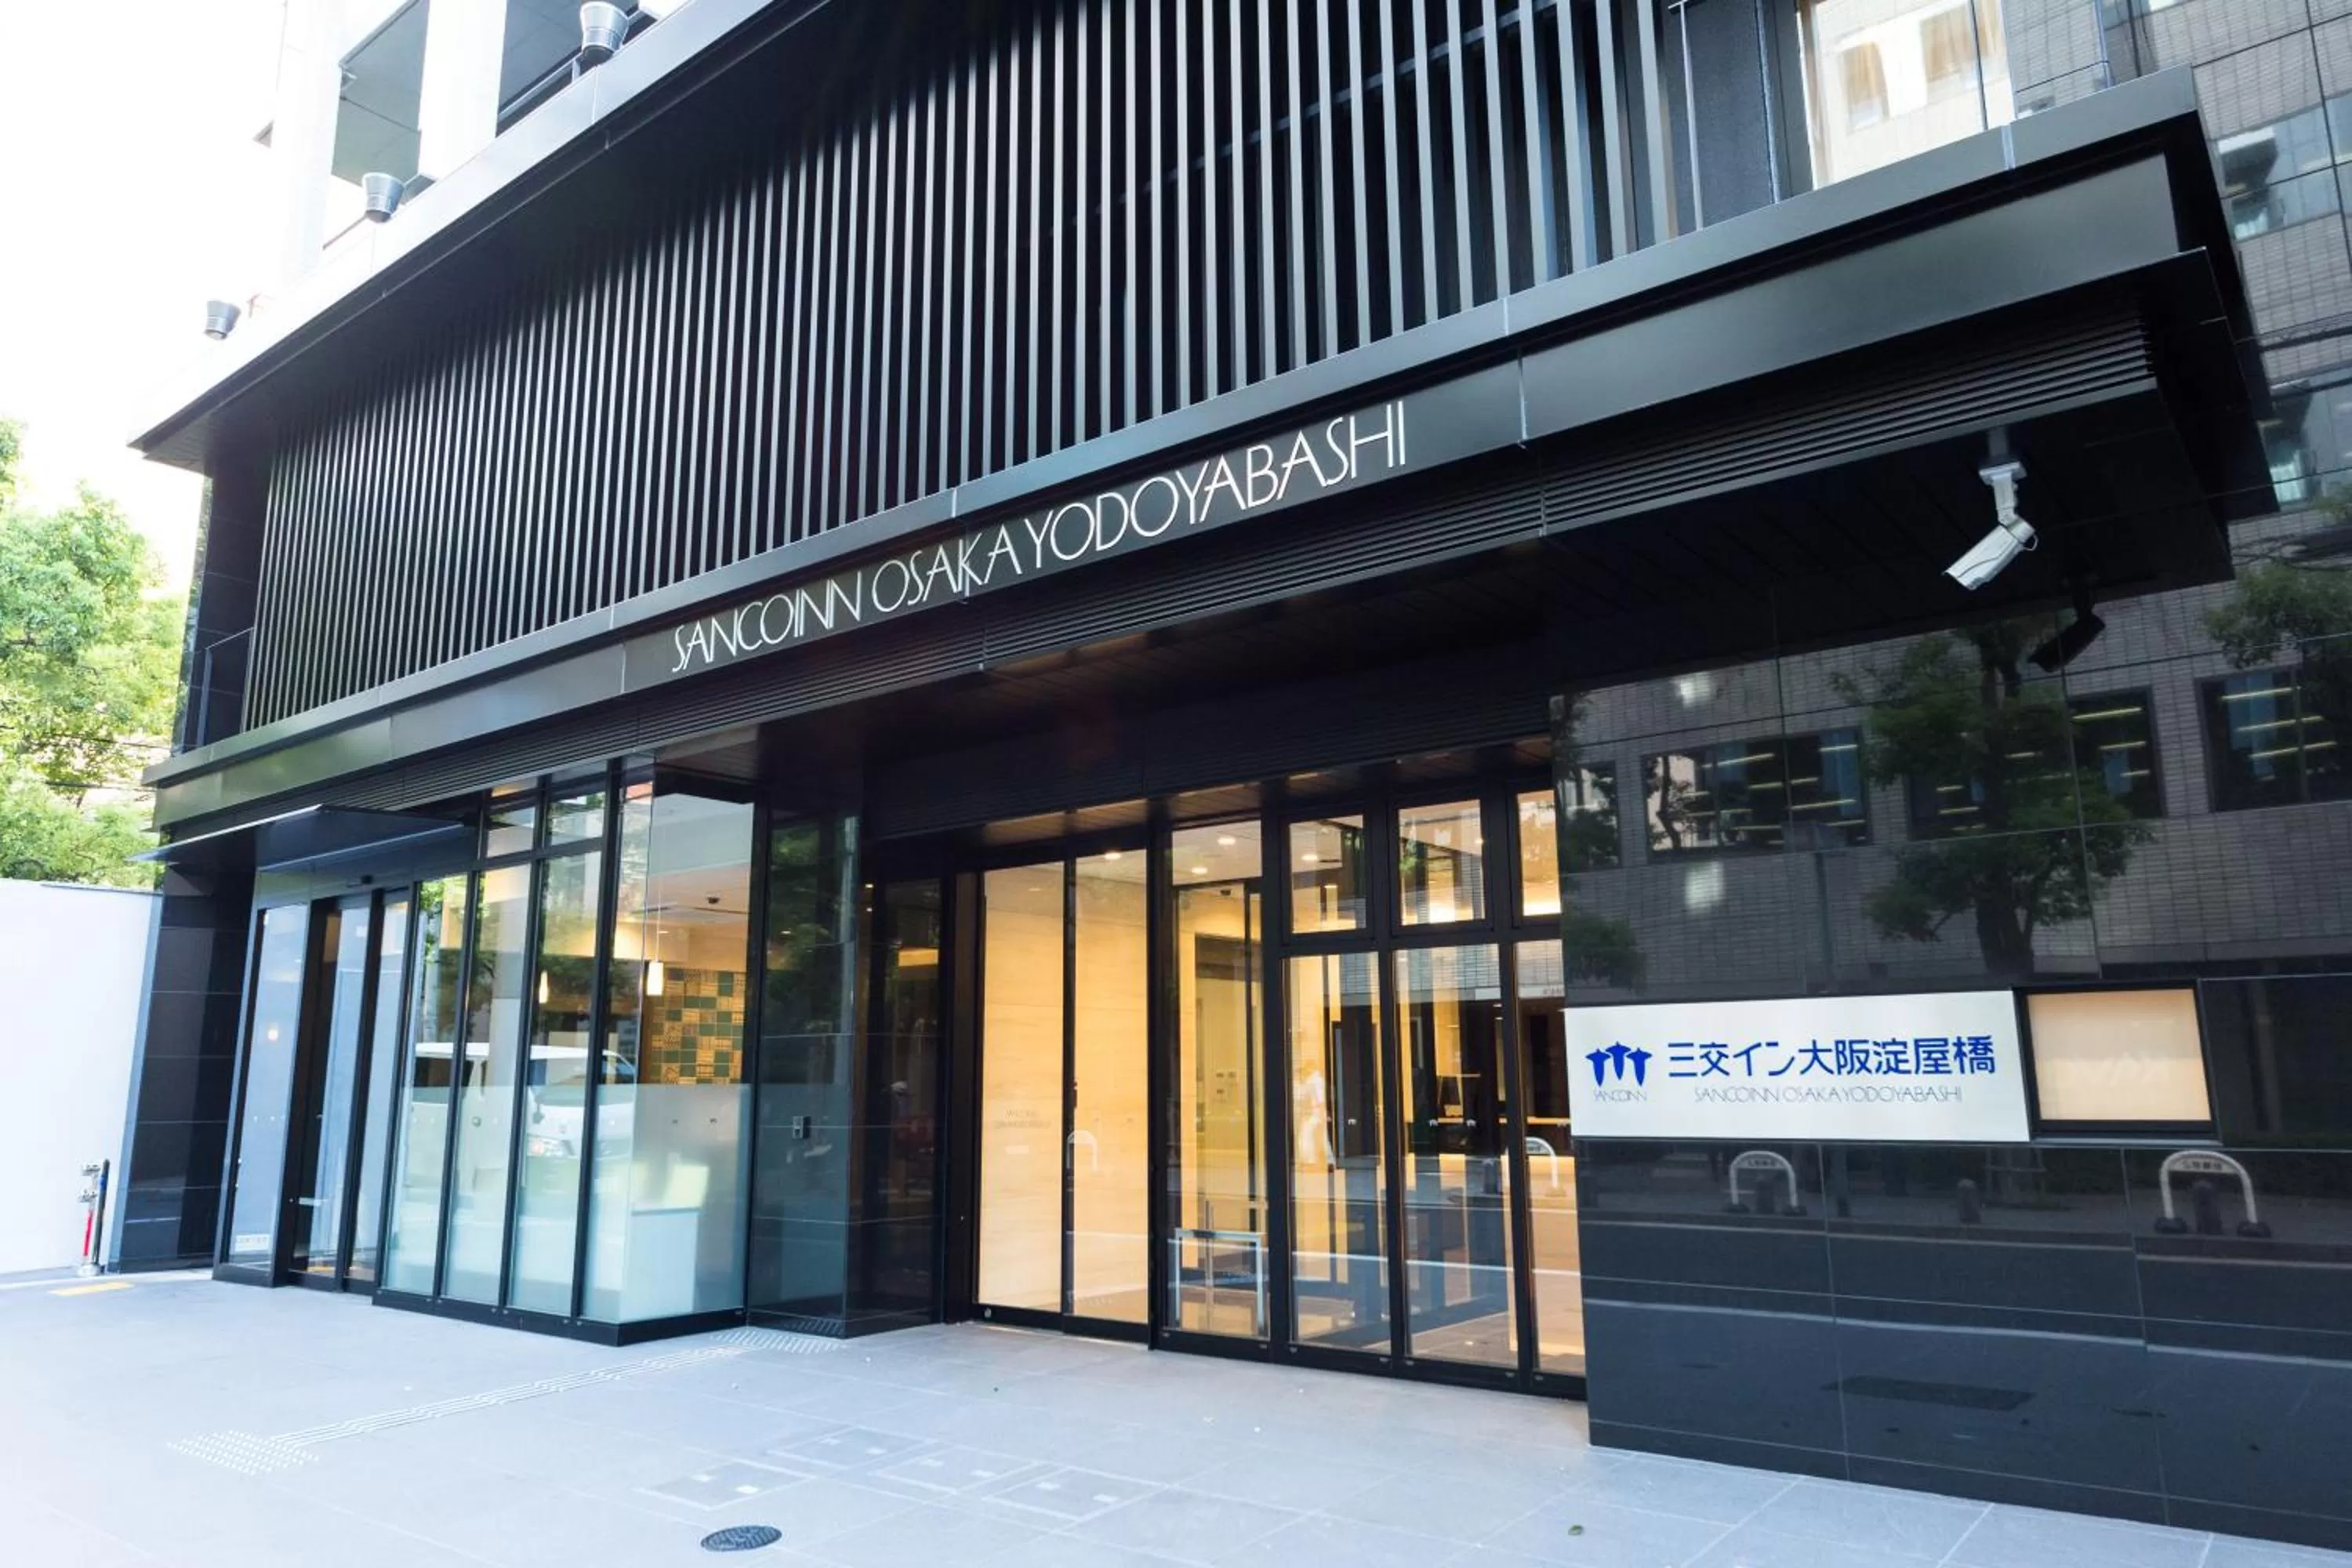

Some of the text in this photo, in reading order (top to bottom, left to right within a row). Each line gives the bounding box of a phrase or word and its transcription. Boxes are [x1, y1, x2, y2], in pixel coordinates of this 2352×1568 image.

[672, 401, 1406, 673] SANCOINN OSAKA YODOYABASHI
[1668, 1035, 1996, 1076] 三交イン大阪淀屋橋
[1694, 1084, 1962, 1103] SANCOINN OSAKA YODOYABASHI
